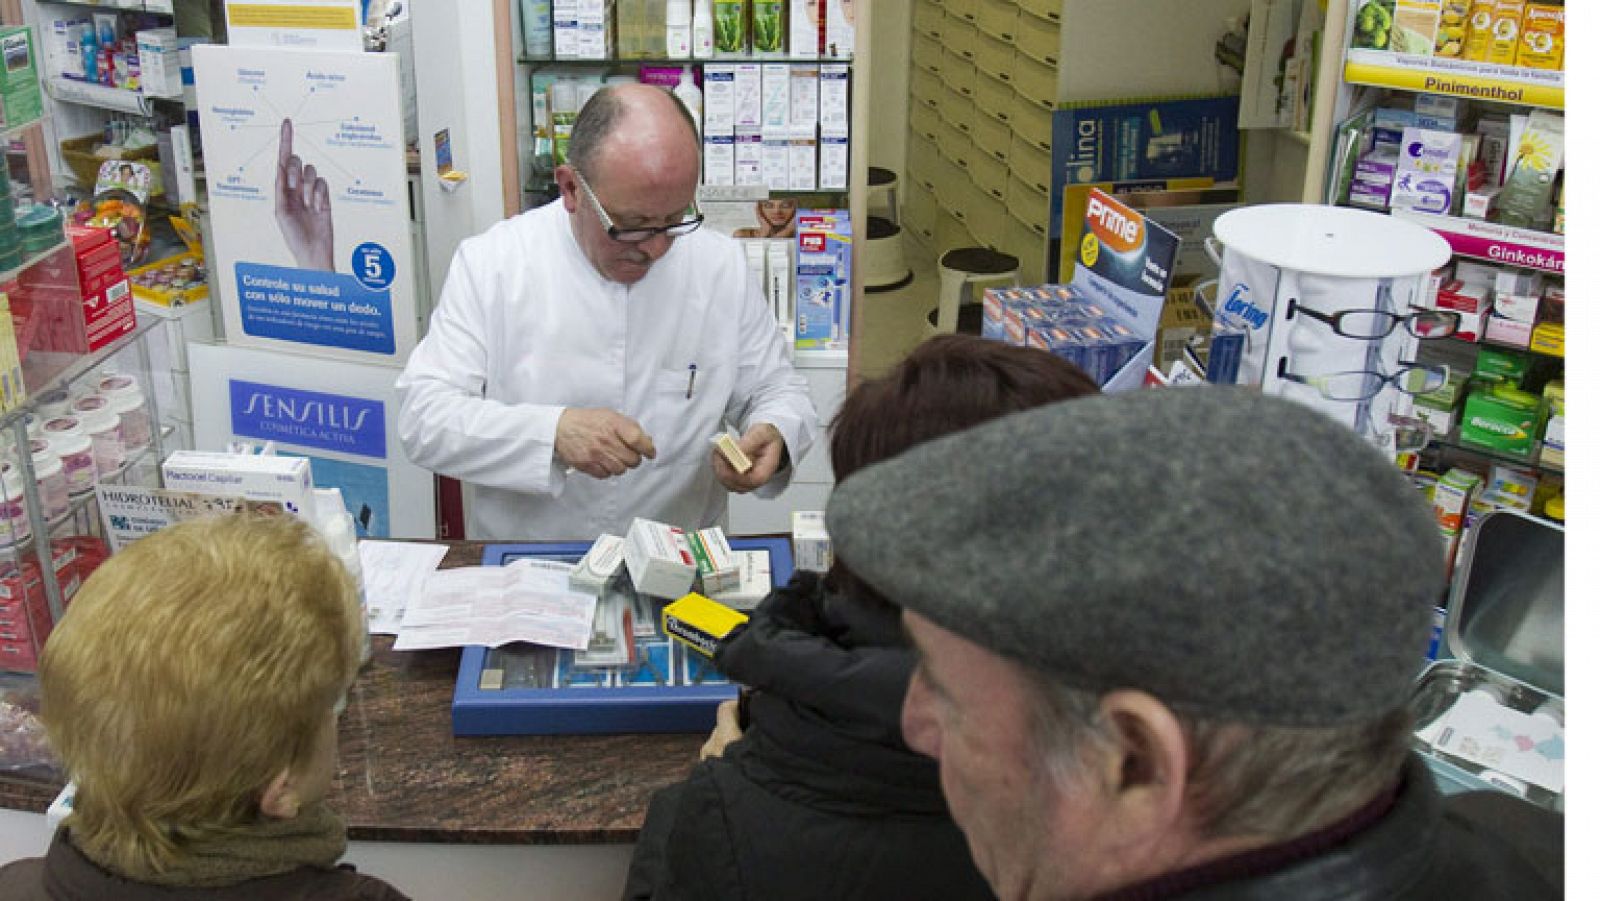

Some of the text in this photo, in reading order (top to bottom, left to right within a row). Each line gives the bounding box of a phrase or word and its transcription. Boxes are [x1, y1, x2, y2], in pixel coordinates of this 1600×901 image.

[1424, 76, 1524, 101] Pinimenthol
[365, 254, 382, 278] 5
[243, 275, 340, 297] Controle su salud
[245, 290, 381, 316] con sólo mover un dedo.
[243, 392, 371, 431] SENSILIS
